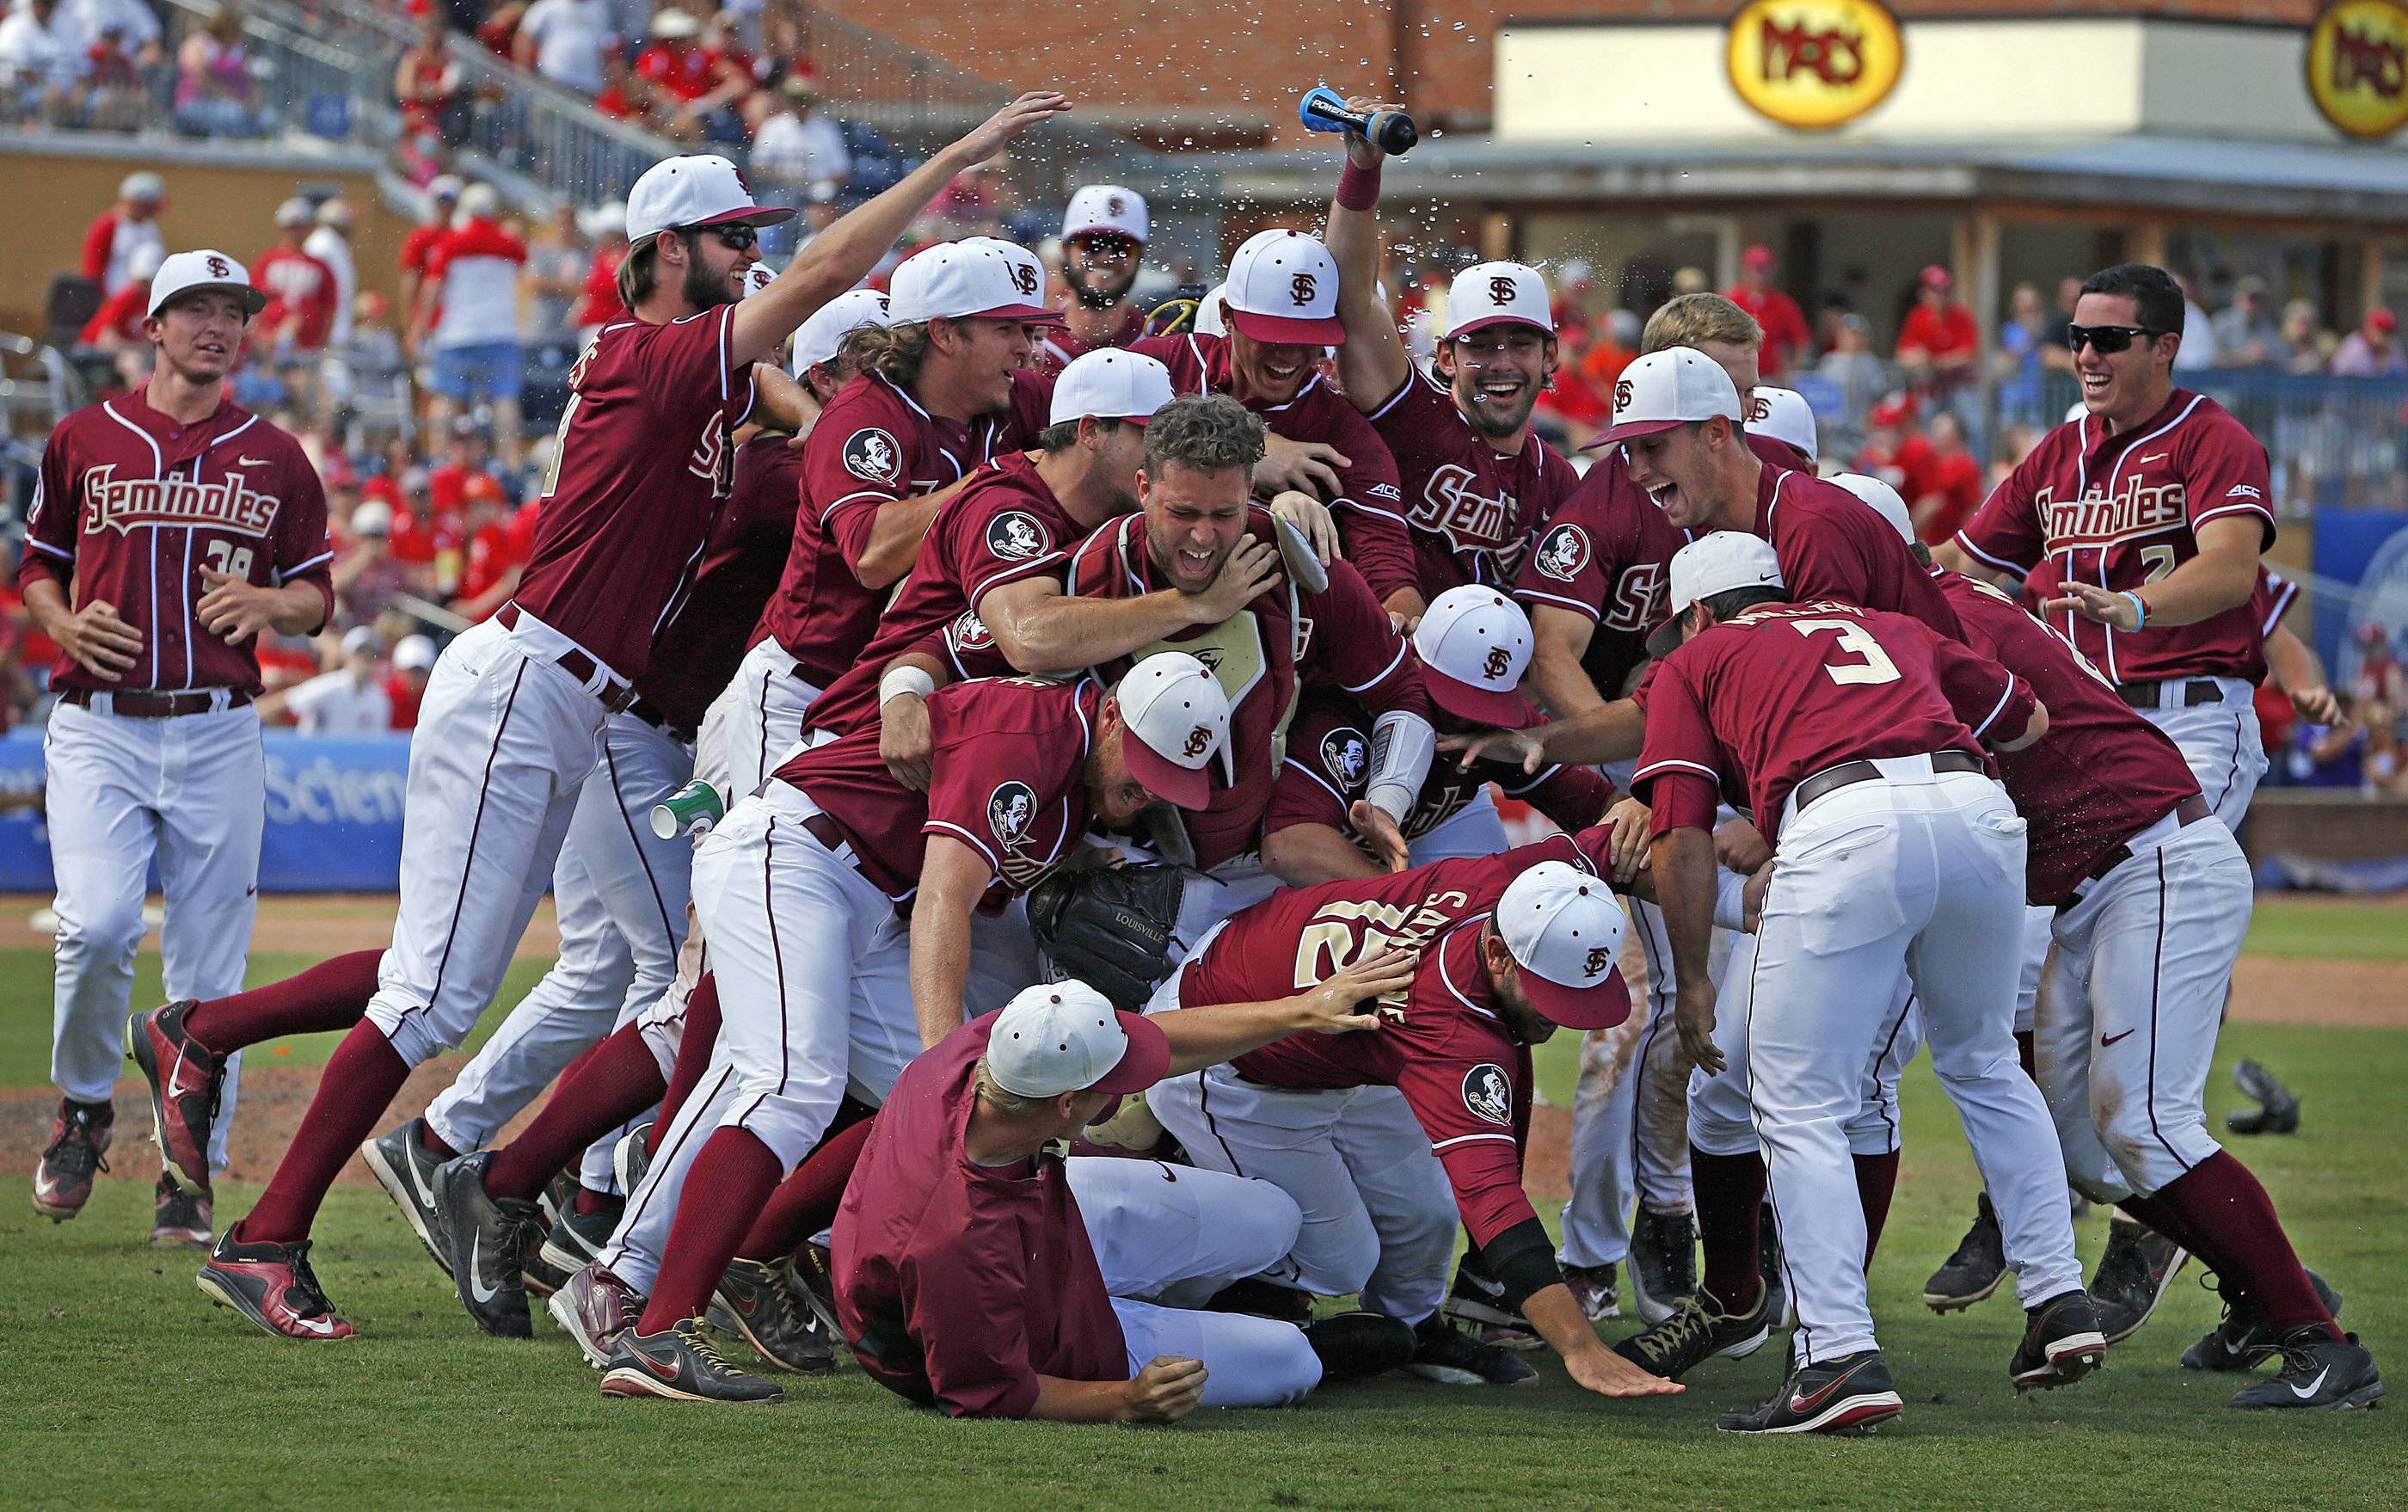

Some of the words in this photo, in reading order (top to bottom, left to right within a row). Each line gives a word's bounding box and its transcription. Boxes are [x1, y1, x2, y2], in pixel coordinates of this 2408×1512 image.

[84, 464, 280, 538] Seminoles
[1369, 482, 1402, 499] ACC
[2227, 483, 2261, 499] ACC
[1790, 618, 1903, 685] 3
[1115, 912, 1165, 944] LOUISVILLE
[808, 1248, 825, 1274] NOLES
[593, 1284, 605, 1298] 20
